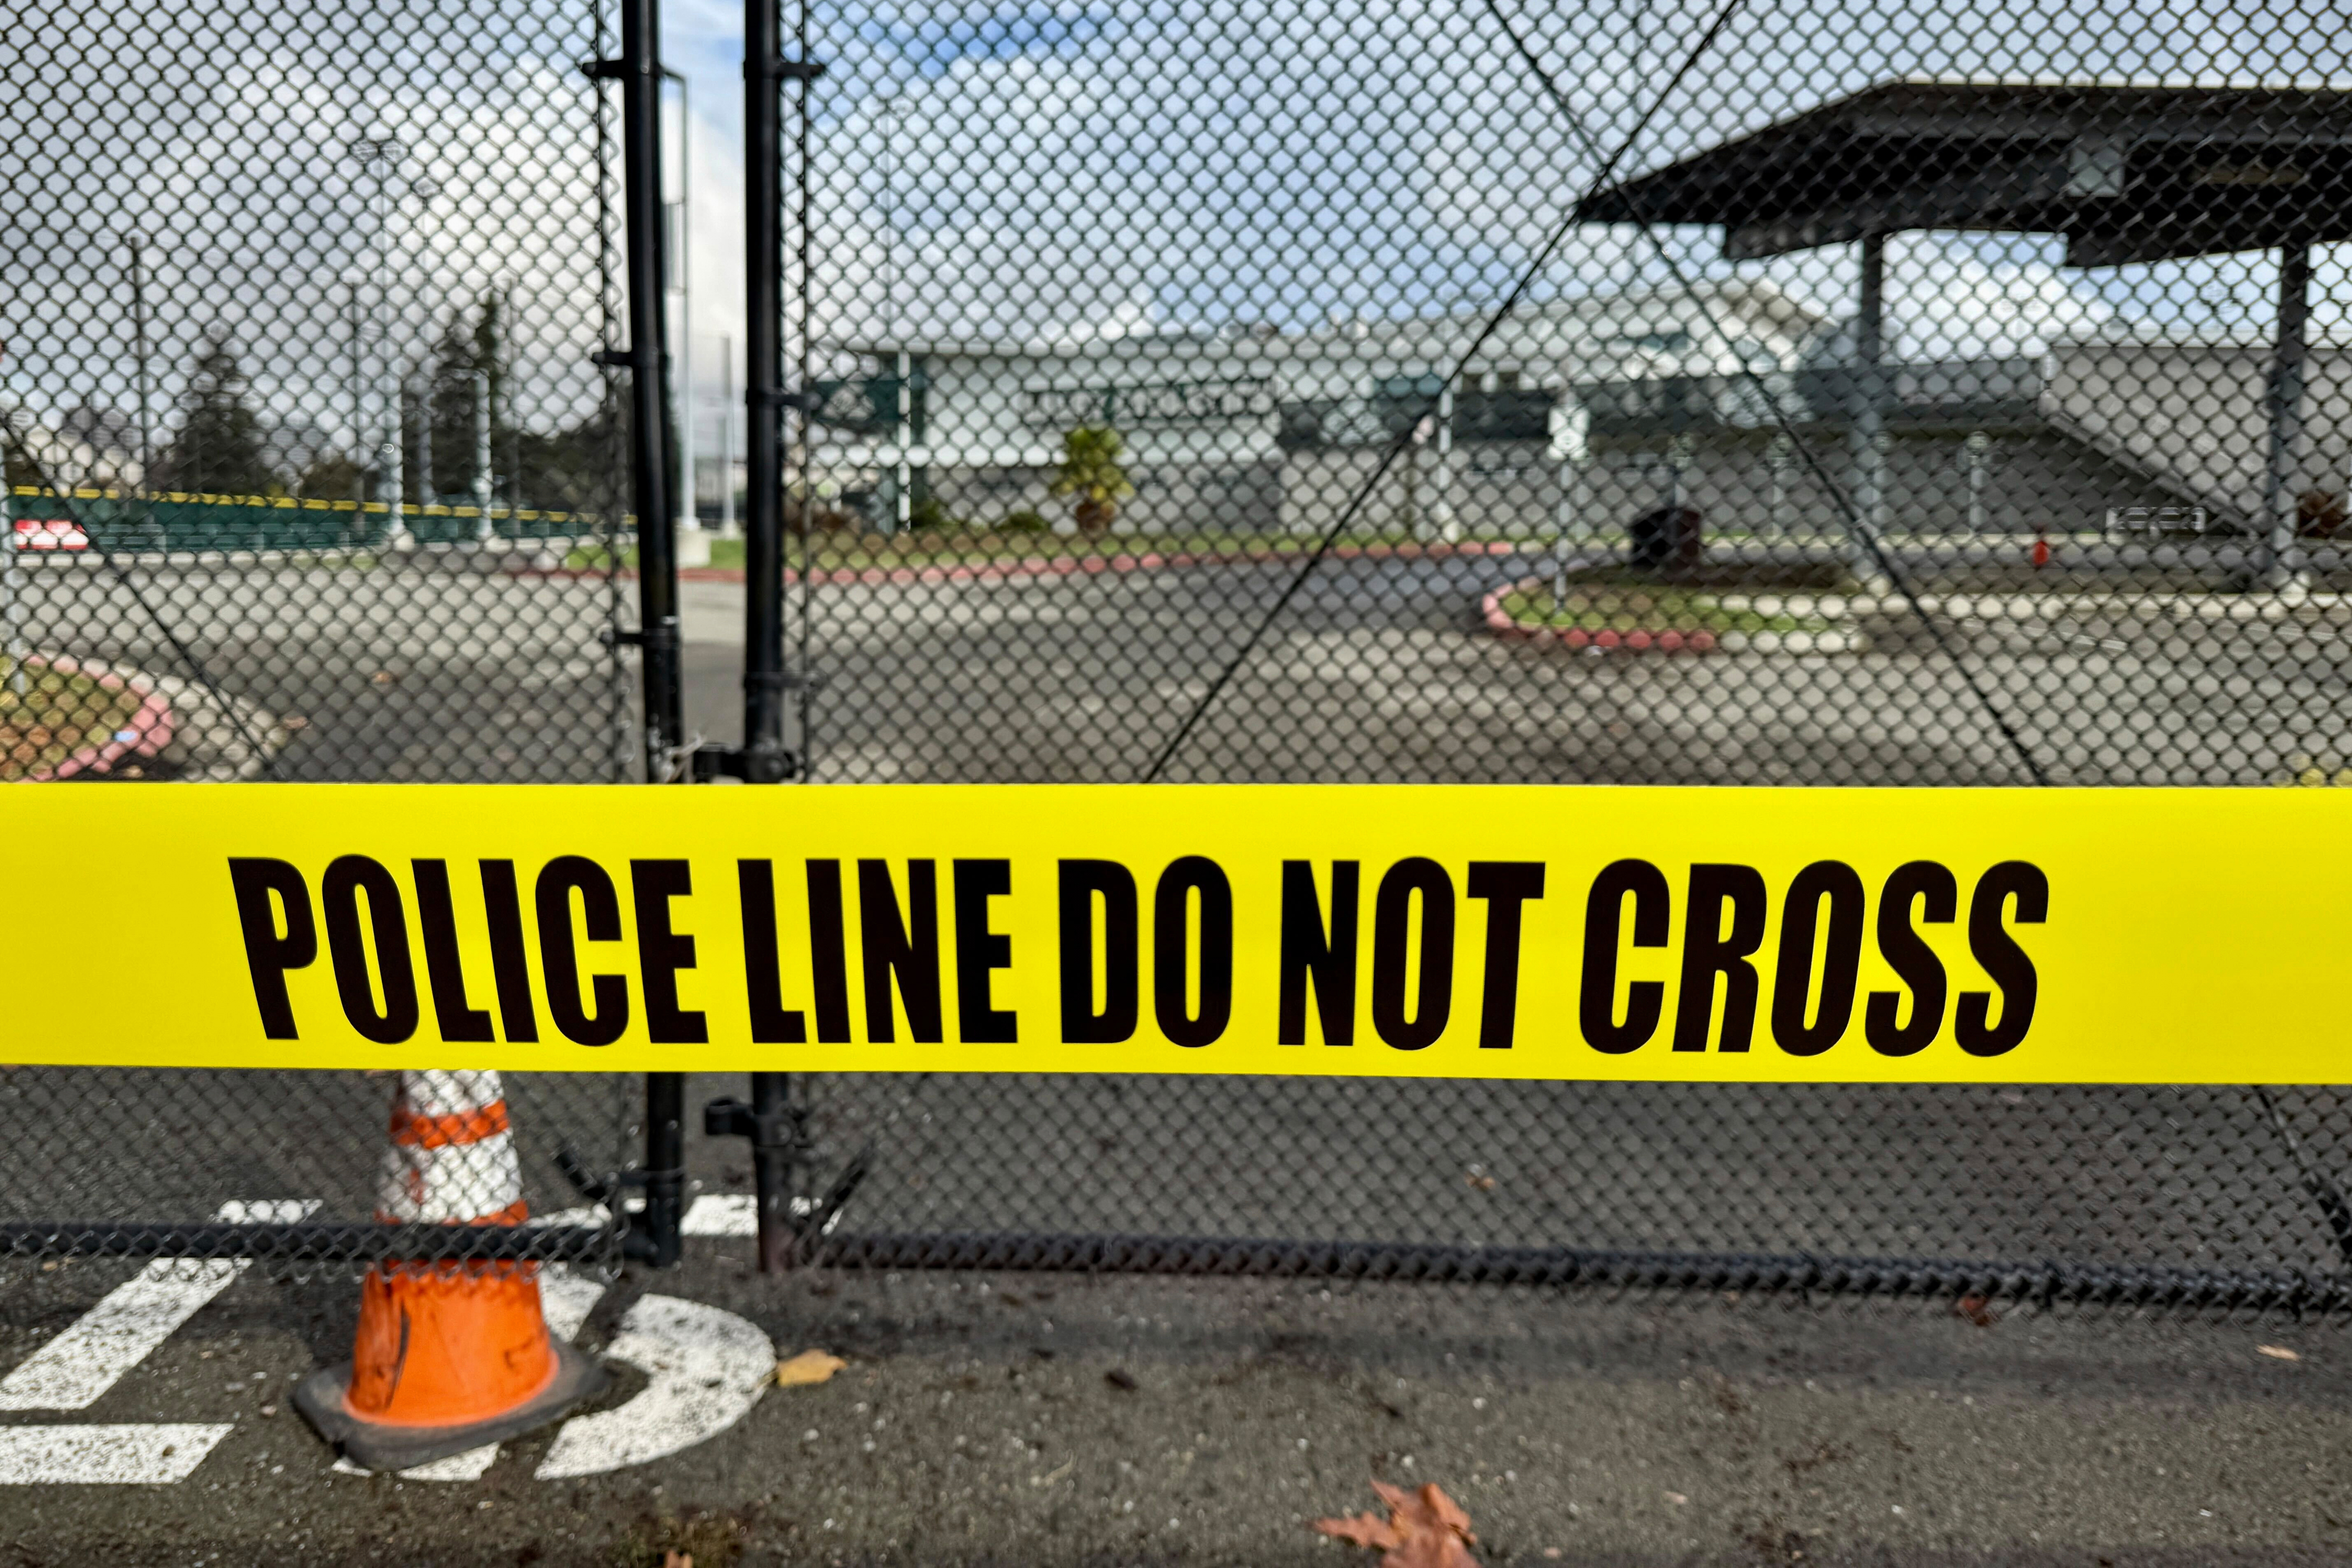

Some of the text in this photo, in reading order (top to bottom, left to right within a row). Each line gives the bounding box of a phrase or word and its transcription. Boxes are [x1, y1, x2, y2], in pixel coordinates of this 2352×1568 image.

[228, 854, 2049, 1057] POLICE LINE DO NOT CROSS
